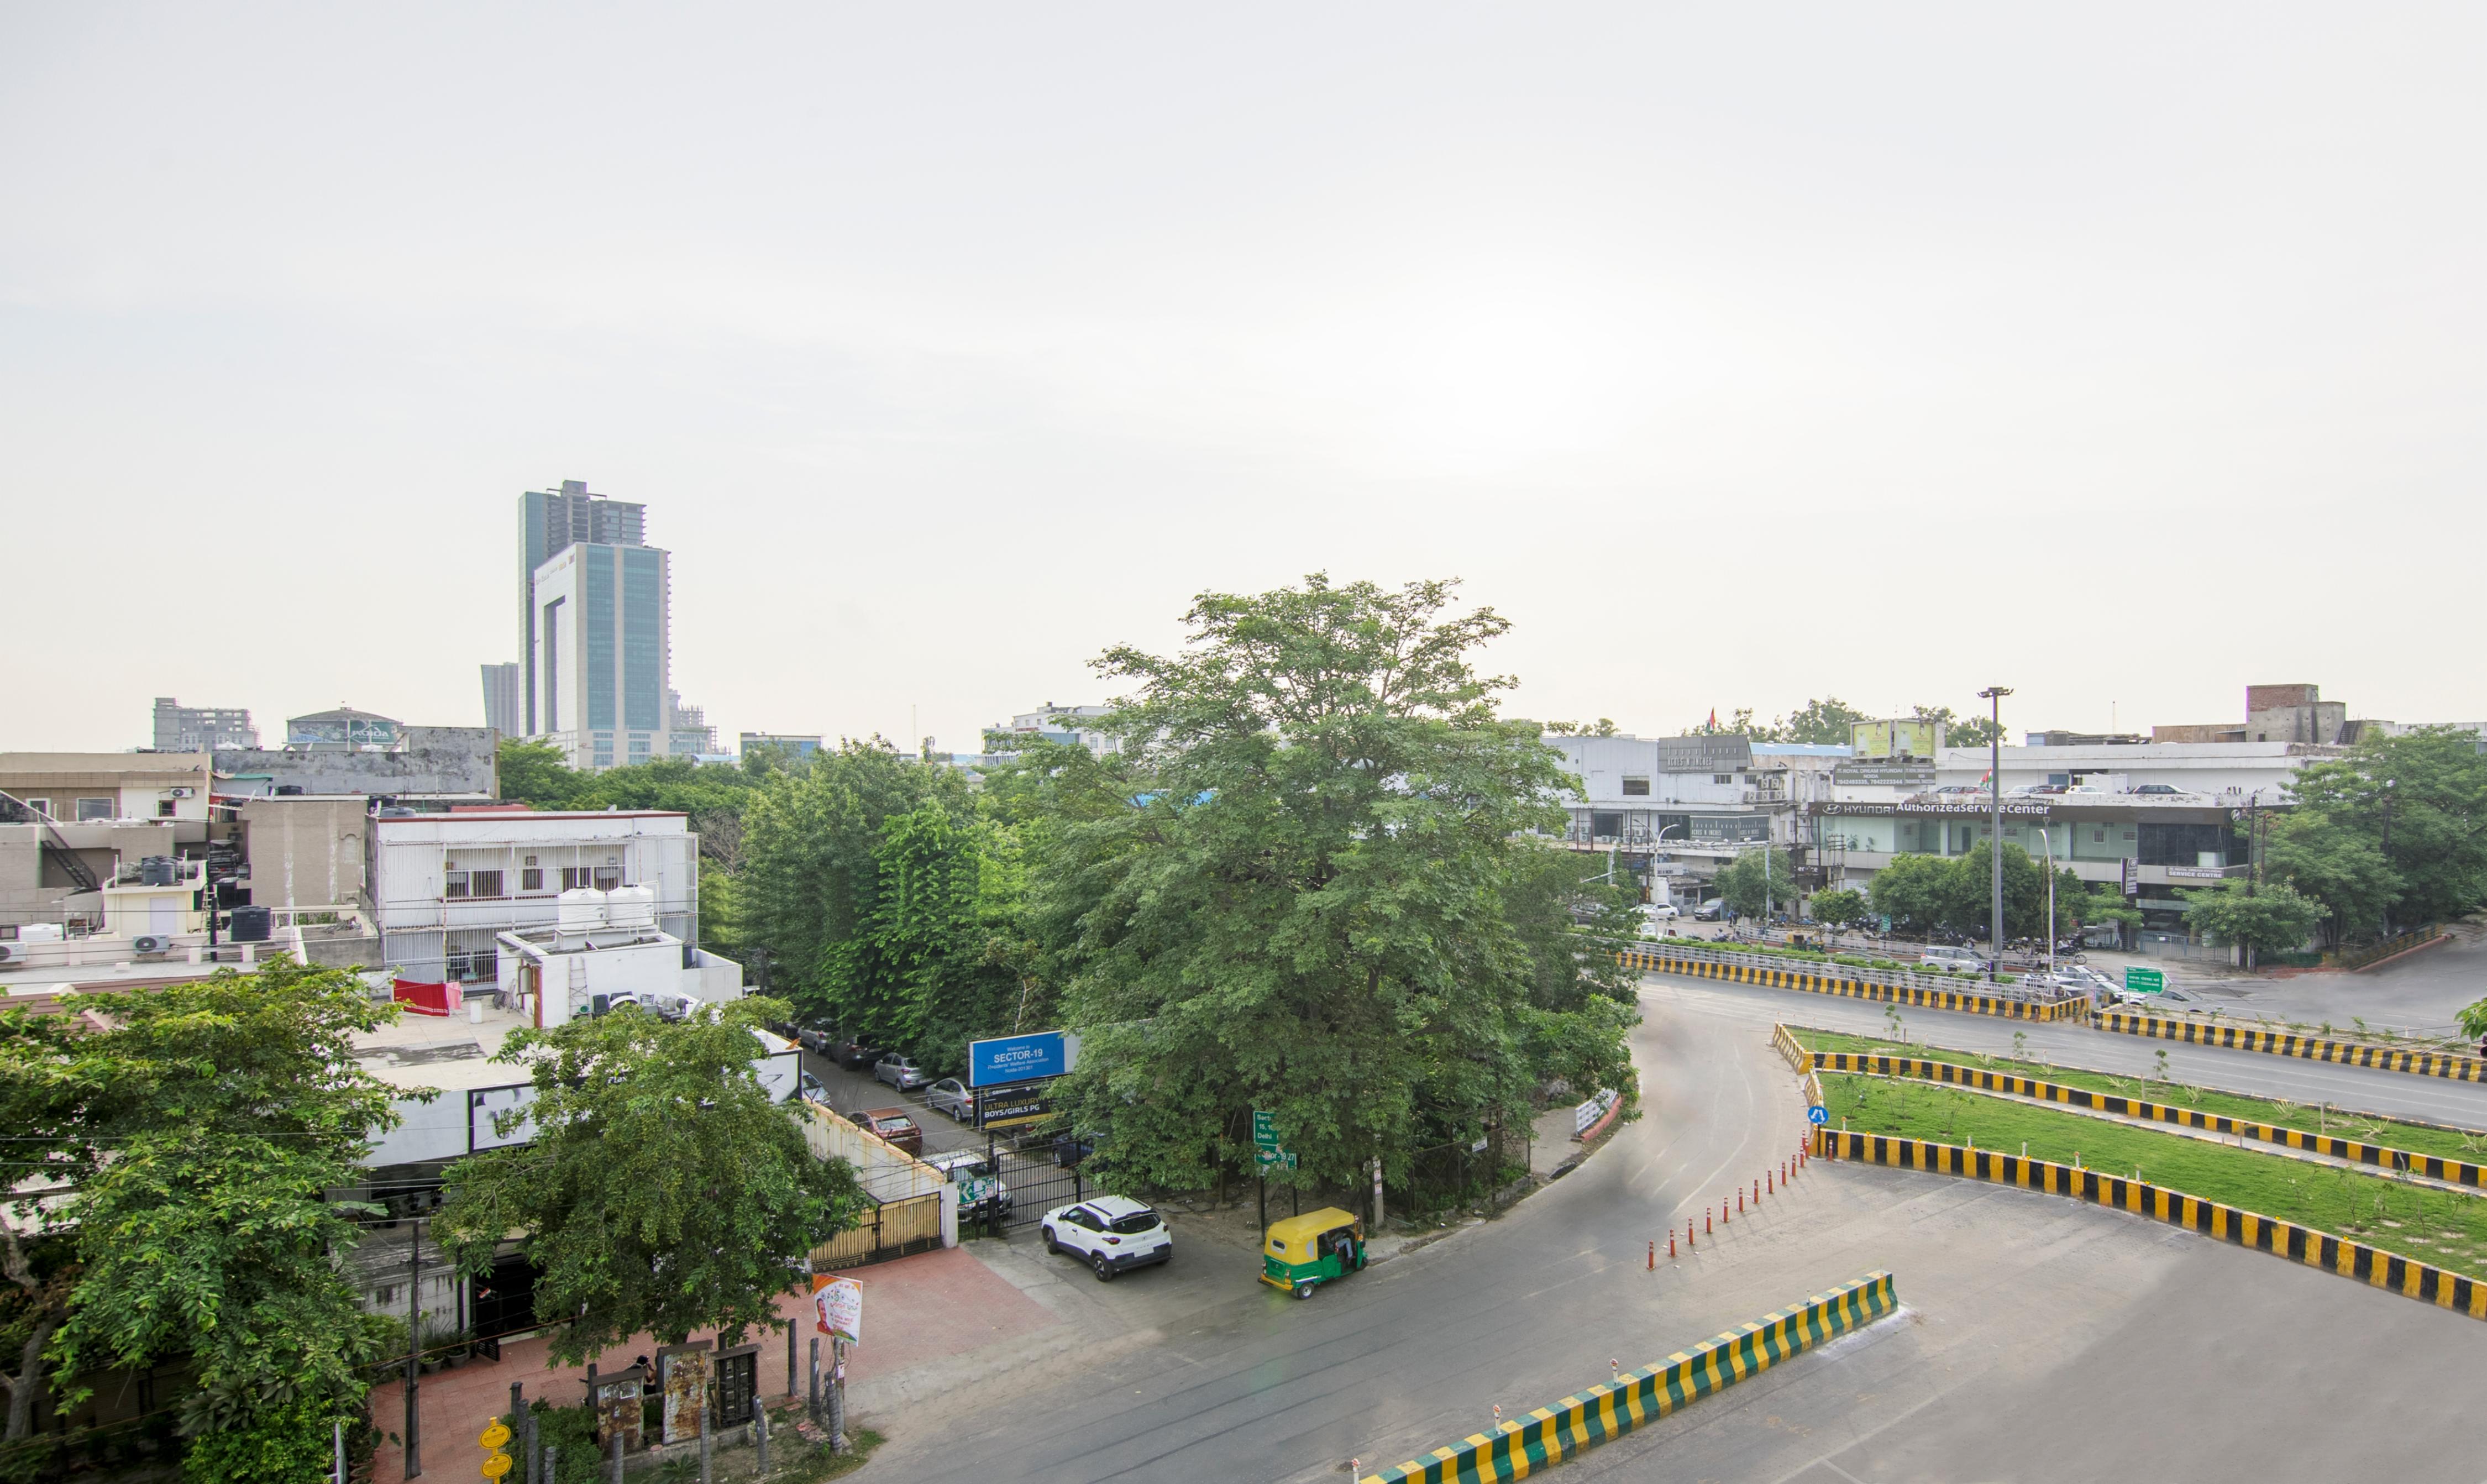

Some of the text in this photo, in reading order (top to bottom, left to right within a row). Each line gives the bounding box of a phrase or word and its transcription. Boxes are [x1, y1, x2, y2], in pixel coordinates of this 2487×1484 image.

[1844, 805, 1894, 814] HYUNDAI
[1960, 804, 2006, 814] Servie
[994, 1048, 1043, 1063] SECTOR-19
[984, 1097, 1039, 1111] ULTRA LUXURY
[984, 1105, 1029, 1118] BOYS/GIRLS
